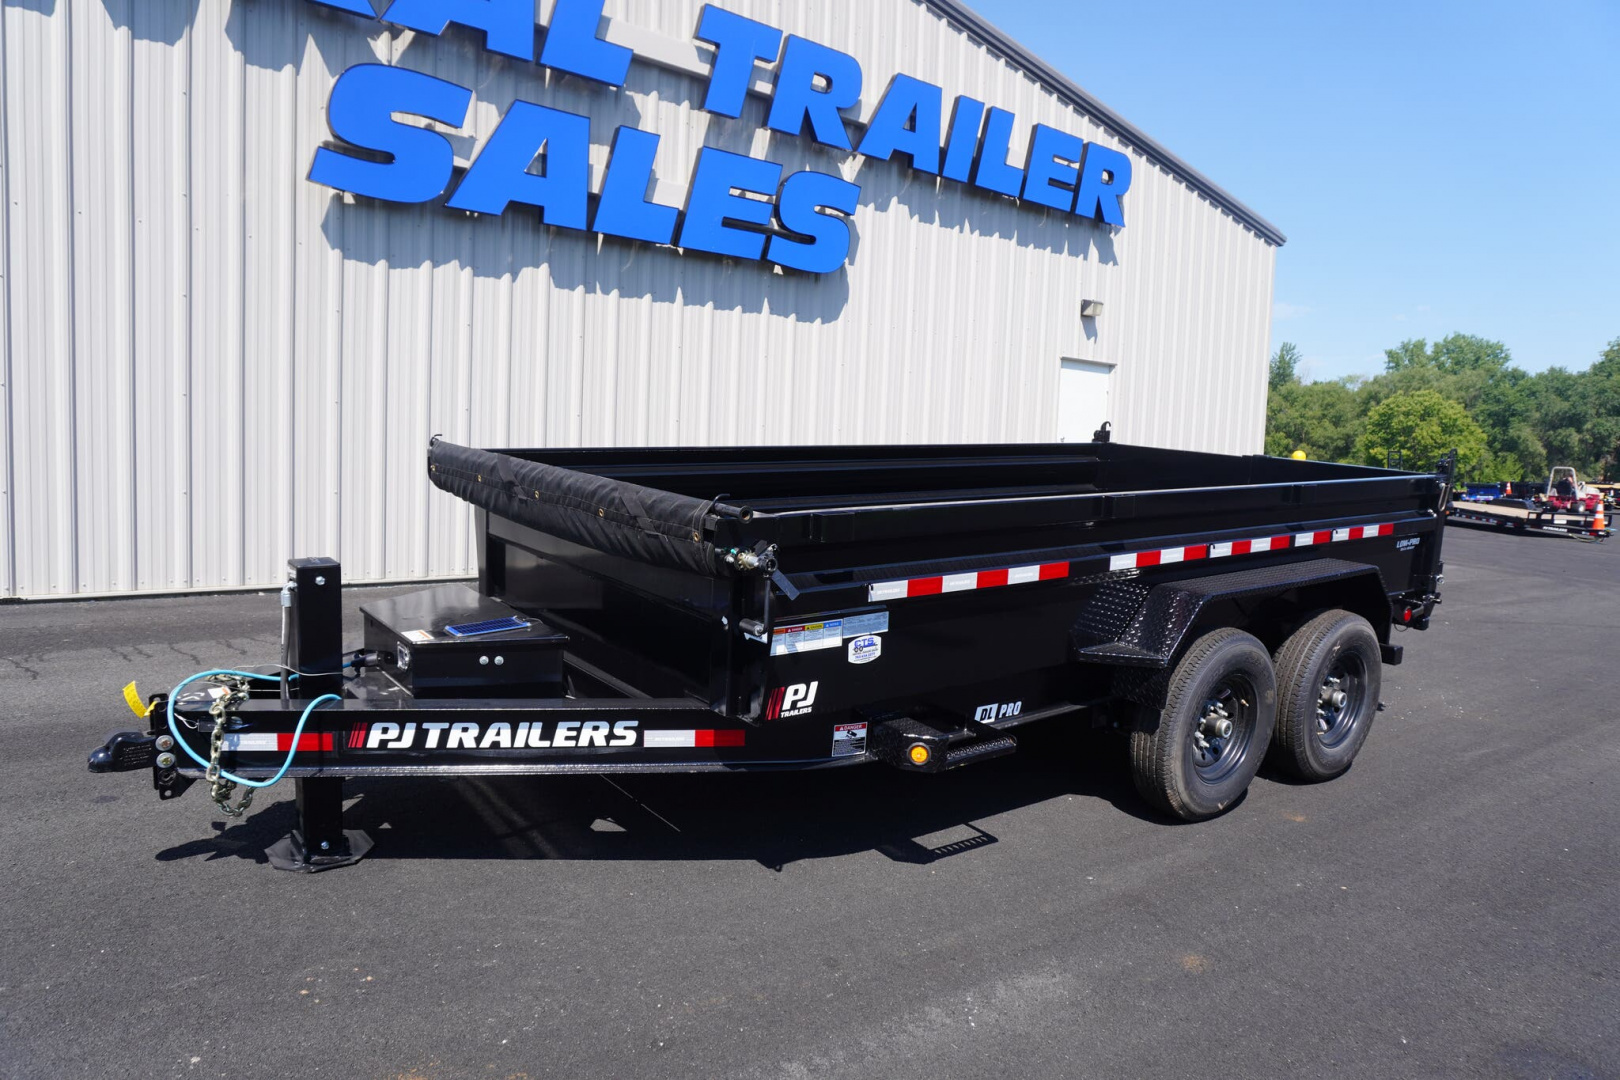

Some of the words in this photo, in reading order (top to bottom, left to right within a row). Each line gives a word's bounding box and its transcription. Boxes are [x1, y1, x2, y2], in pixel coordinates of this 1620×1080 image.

[696, 4, 1132, 227] TRAILER
[308, 62, 862, 274] SALES
[854, 637, 875, 648] CTS
[782, 680, 819, 711] PJ
[998, 701, 1022, 718] PRO
[780, 706, 812, 718] TRAILERS
[366, 721, 417, 750] PJ
[420, 720, 640, 749] TRAILERS
